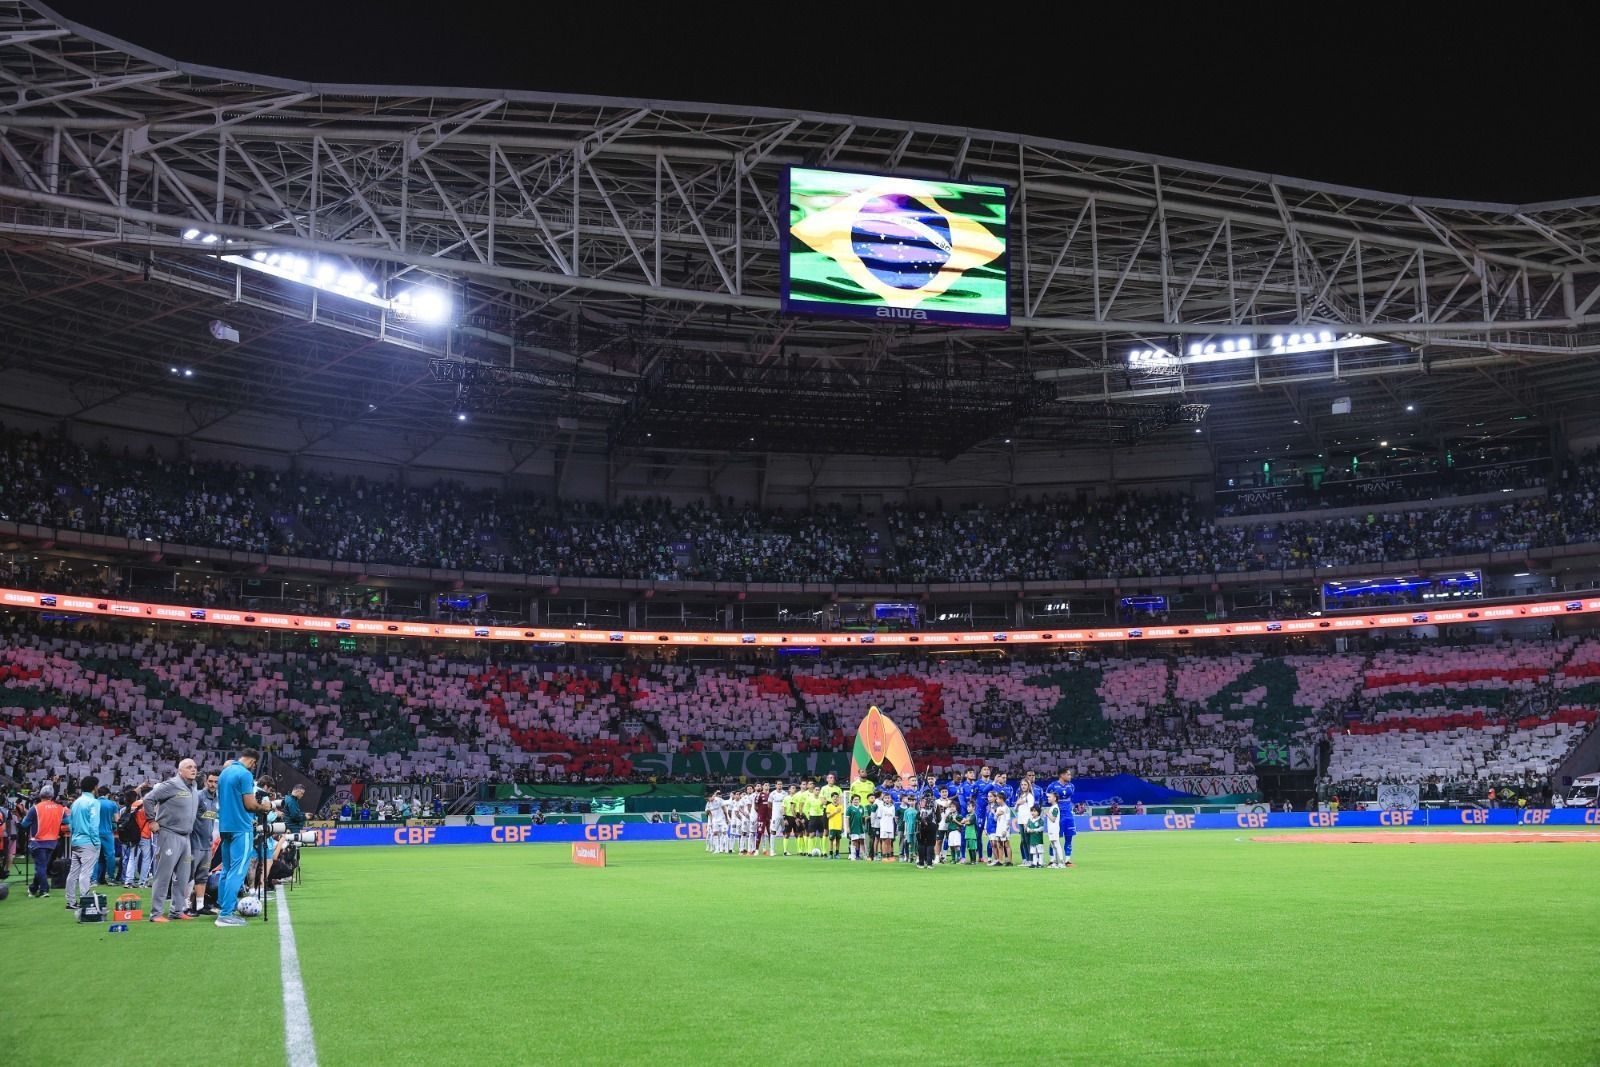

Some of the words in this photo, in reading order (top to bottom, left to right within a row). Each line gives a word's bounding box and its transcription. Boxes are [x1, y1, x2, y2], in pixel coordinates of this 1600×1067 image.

[875, 307, 928, 319] aiwa
[1238, 492, 1283, 502] MIRANTE
[5, 594, 35, 602] aiwa
[64, 600, 93, 608] aiwa
[1531, 605, 1560, 613] aiwa
[629, 752, 850, 777] SAVOIA
[394, 827, 436, 844] CBF
[491, 825, 532, 843] CBF
[584, 823, 624, 841] CBF
[1089, 815, 1122, 831] CBF
[1164, 814, 1195, 829] CBF
[1237, 813, 1268, 828] CBF
[1309, 812, 1339, 826] CBF
[1380, 811, 1413, 825] CBF
[1461, 809, 1489, 824] CBF
[1523, 809, 1551, 824] CBF
